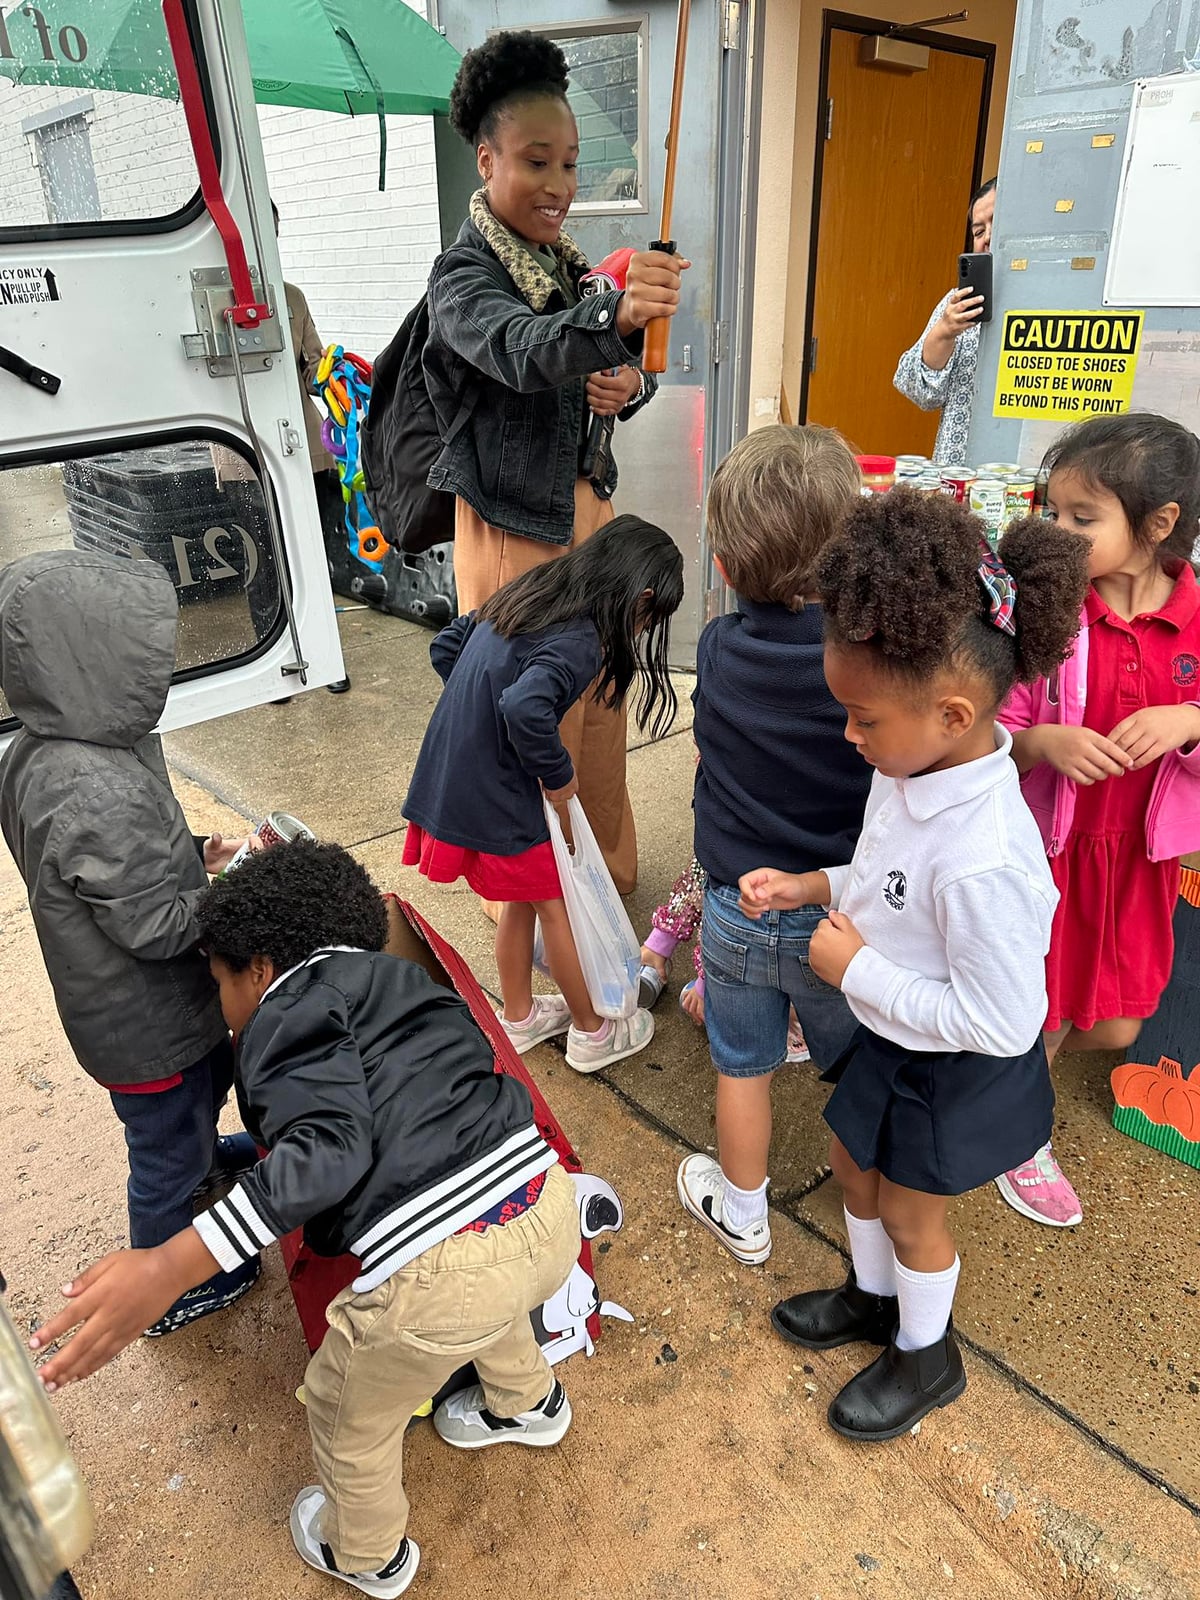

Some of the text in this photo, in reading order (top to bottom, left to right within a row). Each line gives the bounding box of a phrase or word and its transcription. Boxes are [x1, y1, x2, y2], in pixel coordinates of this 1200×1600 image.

[0, 267, 42, 280] CY ONLY
[0, 282, 13, 305] N
[10, 282, 41, 294] PULL UP
[14, 292, 50, 305] AND PUSH
[1009, 318, 1135, 350] CAUTION
[1007, 355, 1127, 373] CLOSED TOE SHOES
[1014, 375, 1113, 392] MUST BE WORN
[1000, 393, 1124, 413] BEYOND THIS POINT
[753, 1226, 764, 1237] NIKE
